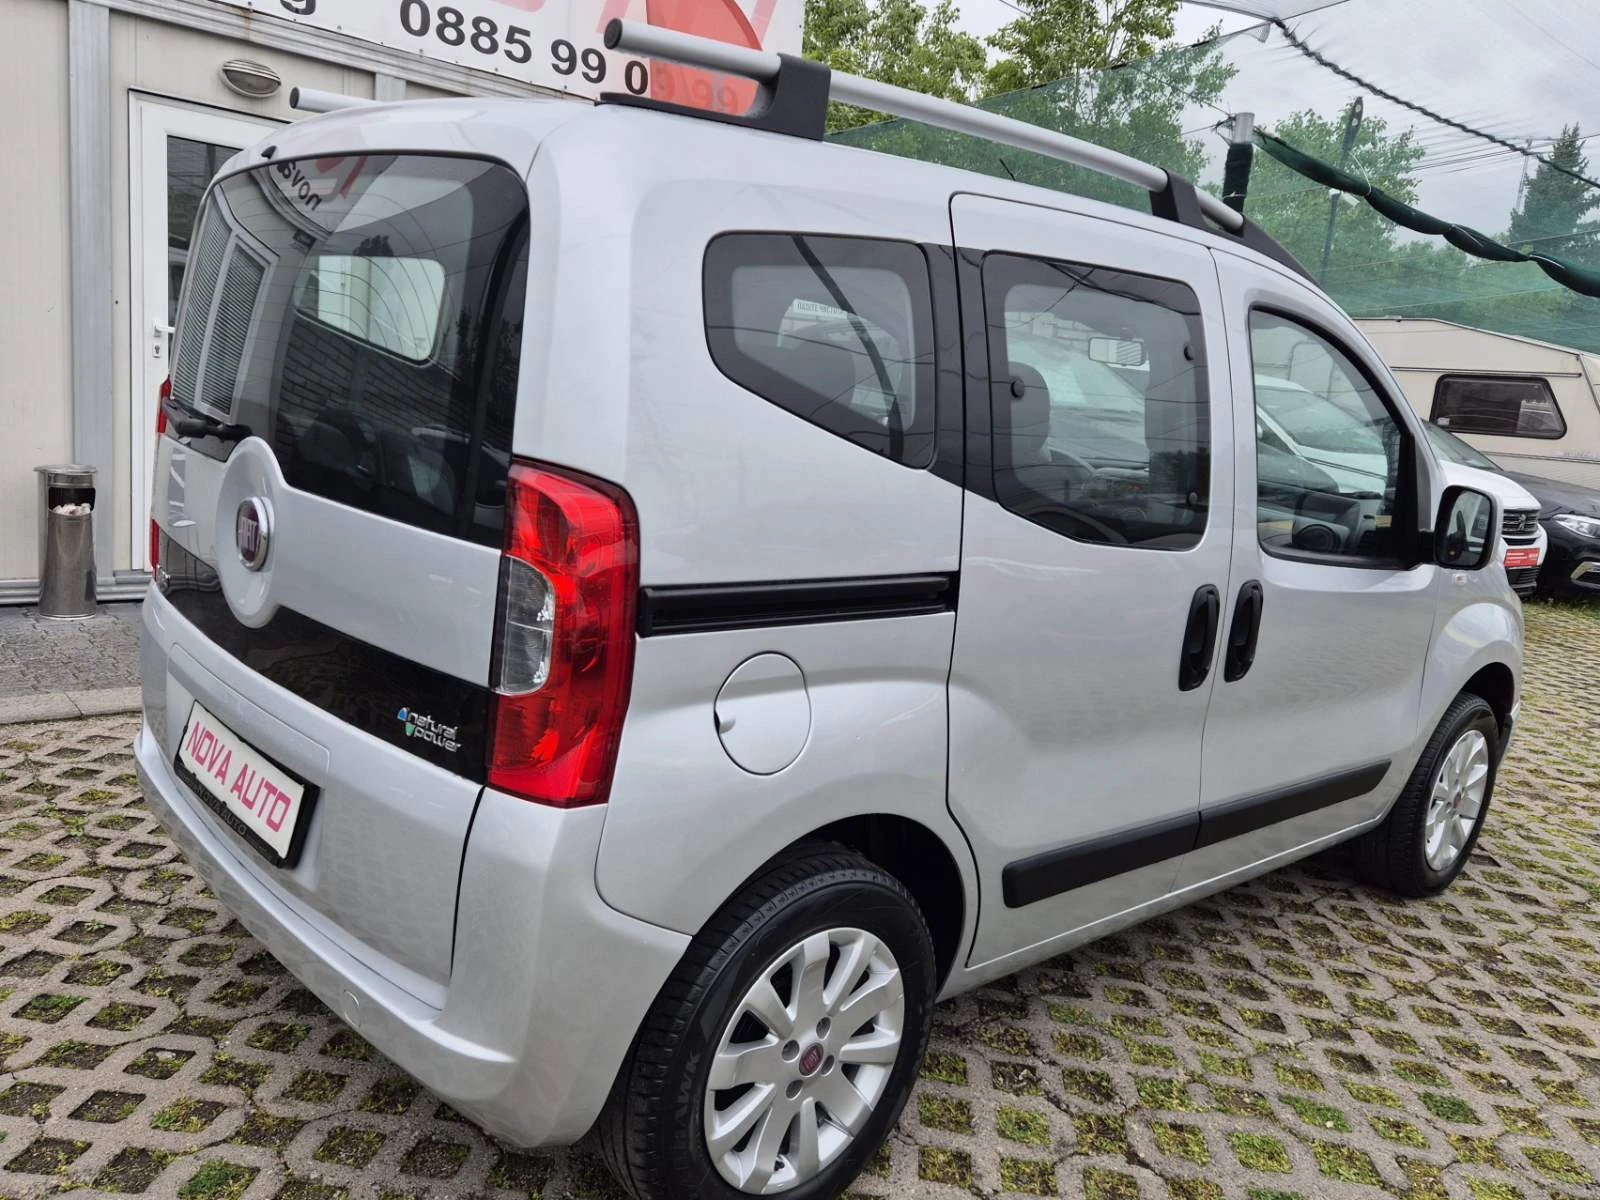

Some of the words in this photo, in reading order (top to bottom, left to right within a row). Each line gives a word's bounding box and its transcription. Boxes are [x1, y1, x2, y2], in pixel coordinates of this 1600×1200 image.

[401, 0, 532, 64] 0885
[551, 39, 606, 84] 99
[408, 712, 458, 740] natural
[414, 727, 461, 752] power
[186, 721, 232, 785] NOVA
[231, 764, 291, 832] AUTO
